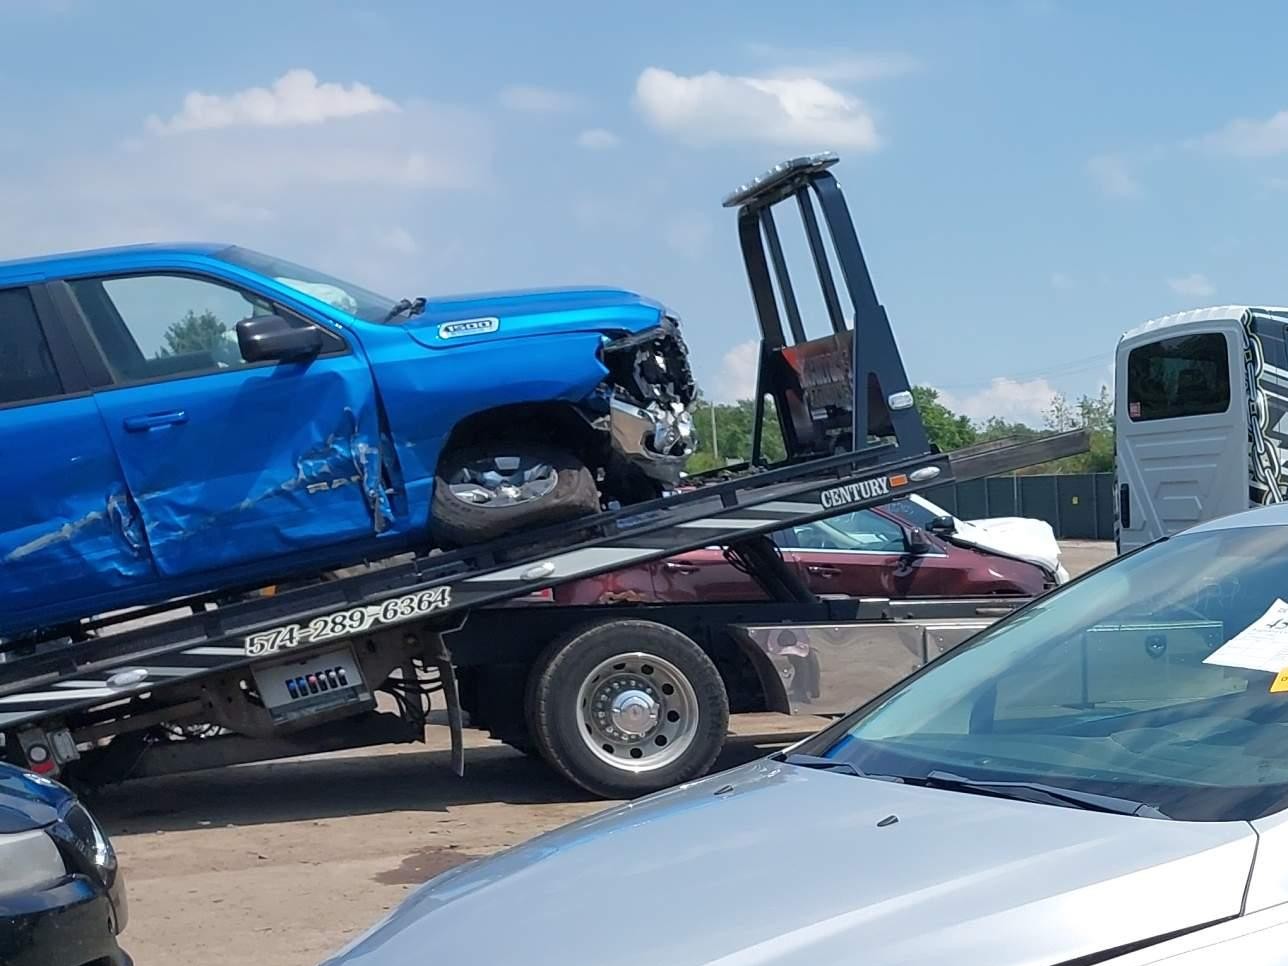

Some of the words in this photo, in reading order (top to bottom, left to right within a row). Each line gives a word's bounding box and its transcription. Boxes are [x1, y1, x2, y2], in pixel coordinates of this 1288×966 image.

[444, 319, 493, 333] 1500
[821, 476, 889, 508] CENTURY
[246, 586, 451, 656] 574-289-6364
